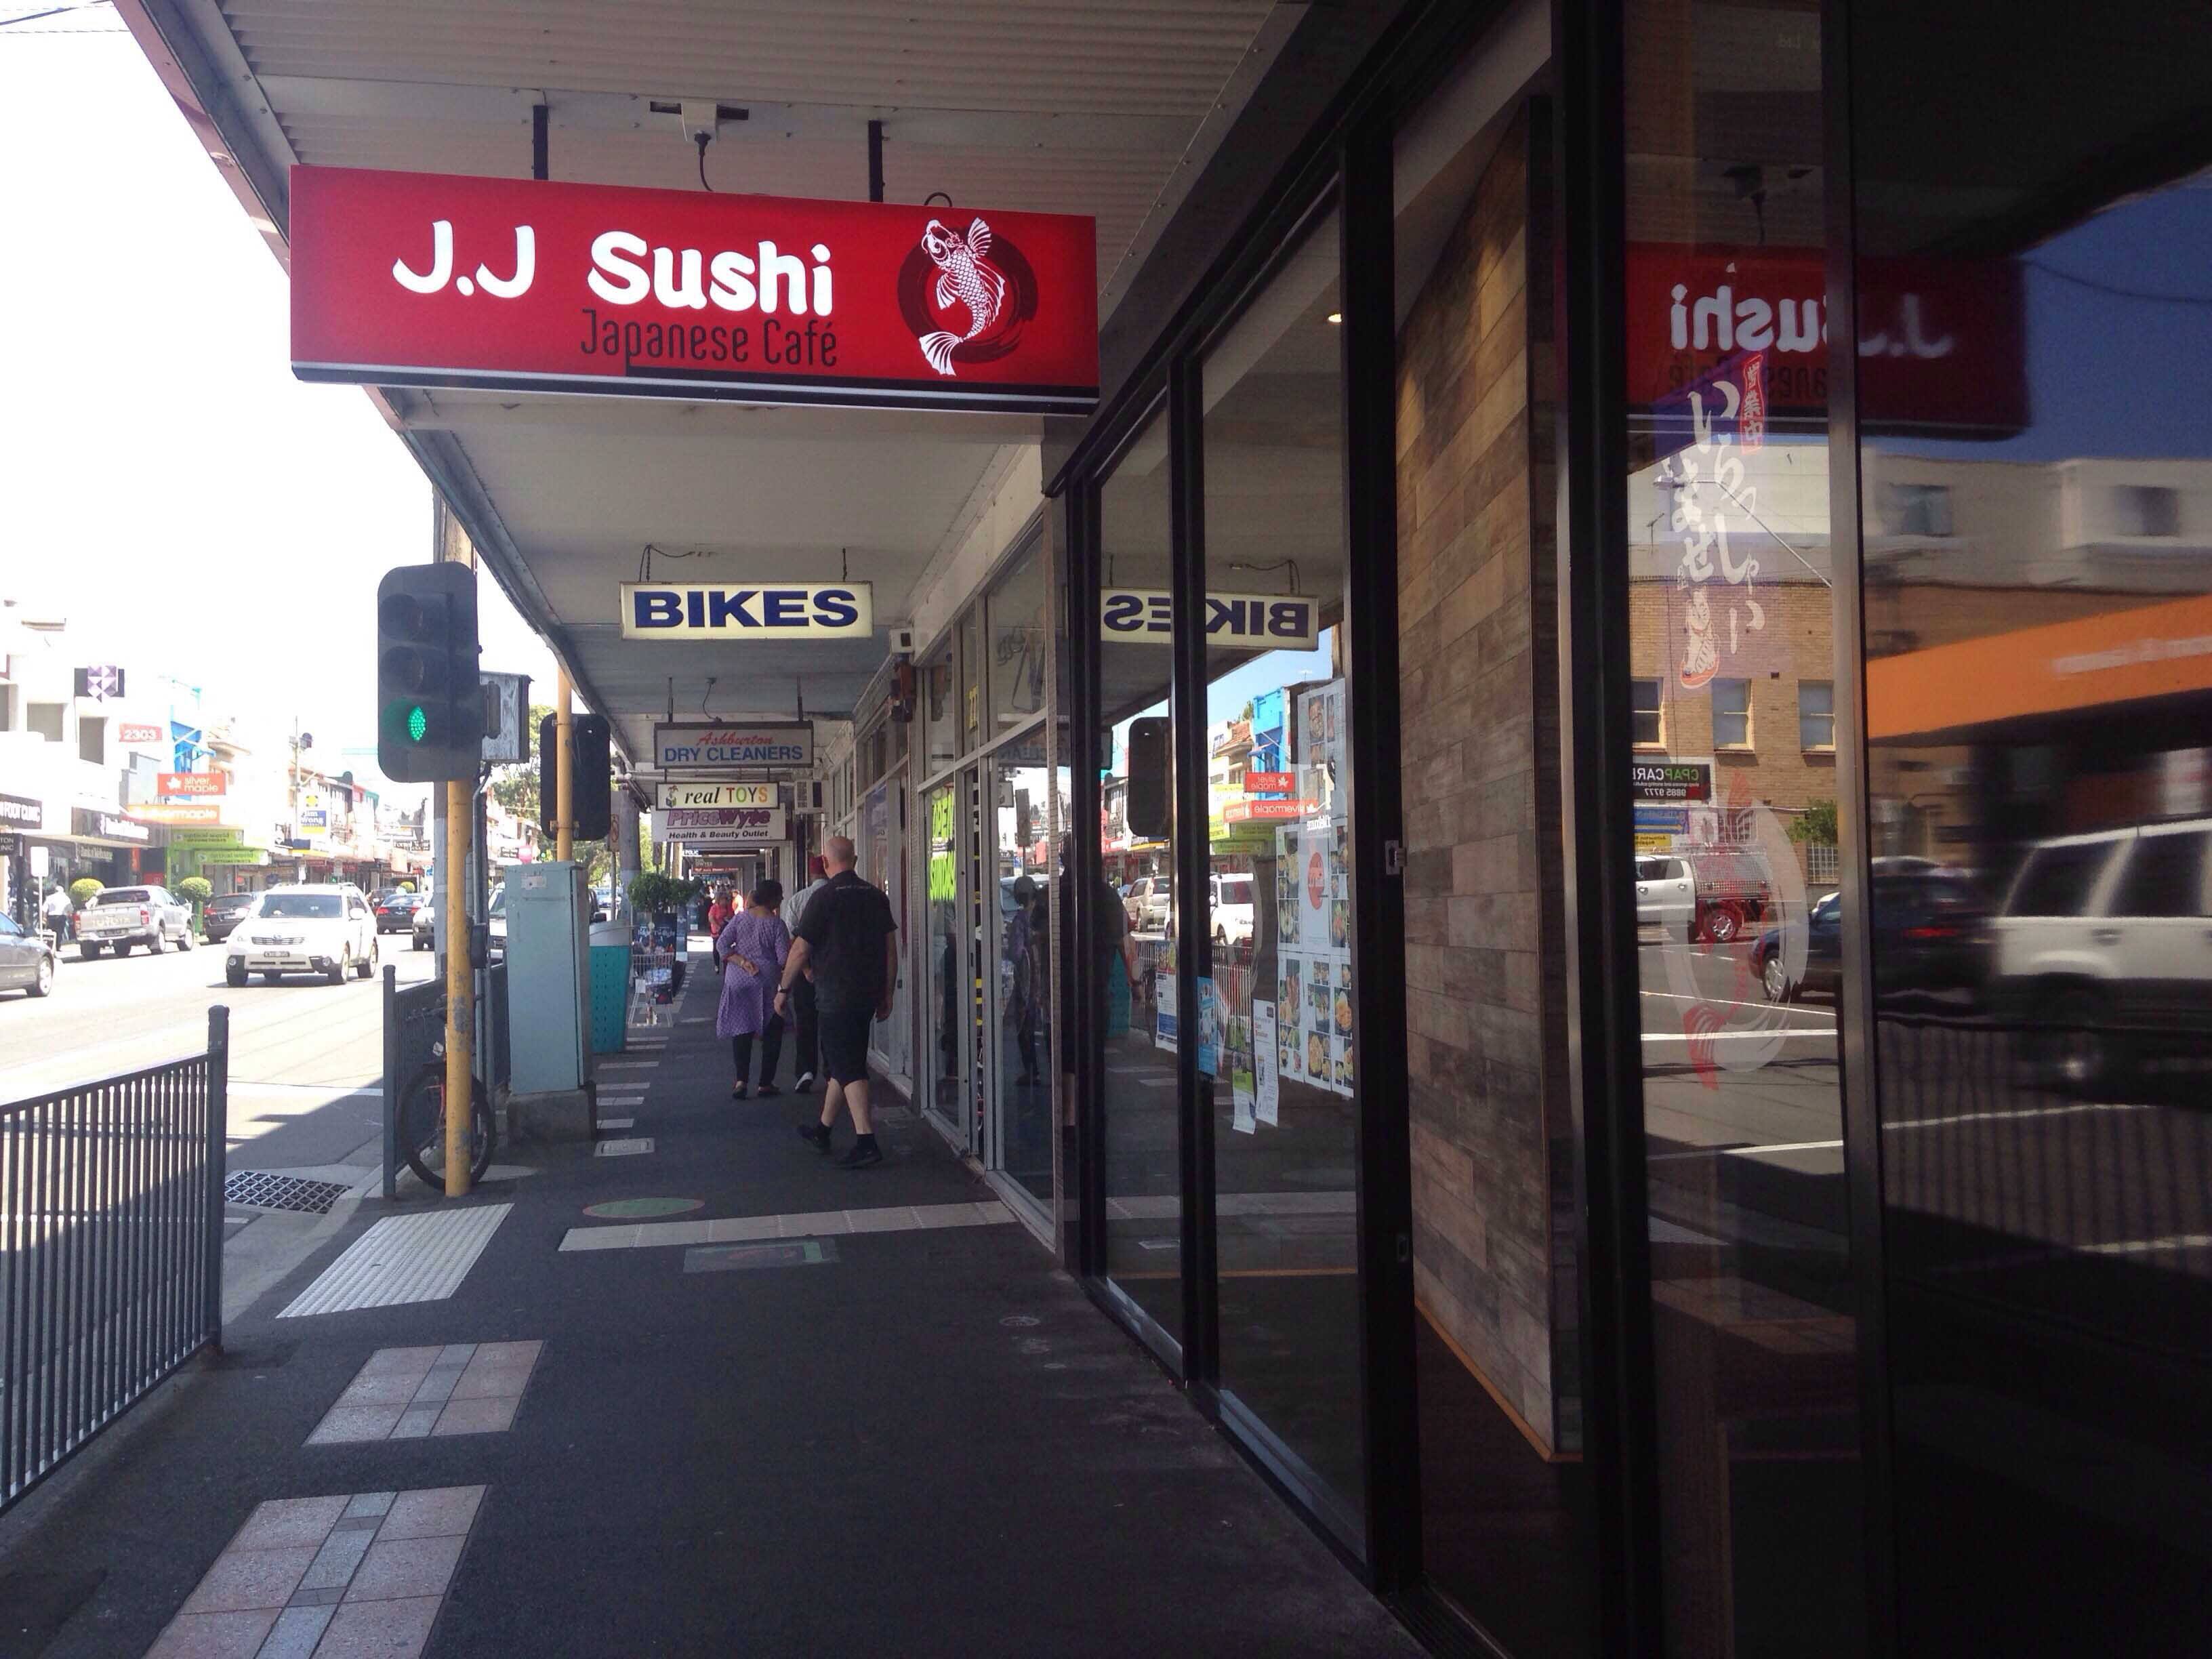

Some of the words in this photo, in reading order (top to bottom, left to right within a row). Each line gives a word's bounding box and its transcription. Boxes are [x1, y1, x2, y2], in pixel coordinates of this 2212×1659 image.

[392, 219, 537, 300] J.J
[587, 228, 835, 317] Sushi
[581, 309, 750, 369] Japanese
[764, 319, 838, 367] Café
[634, 589, 859, 628] BIKES
[696, 731, 775, 745] Ashburton
[664, 747, 701, 762] DRY
[707, 745, 803, 762] CLEANERS
[184, 777, 210, 785] silver
[184, 783, 218, 793] maple
[684, 785, 720, 804] real
[725, 785, 769, 803] TOYS
[710, 831, 740, 840] Beauty
